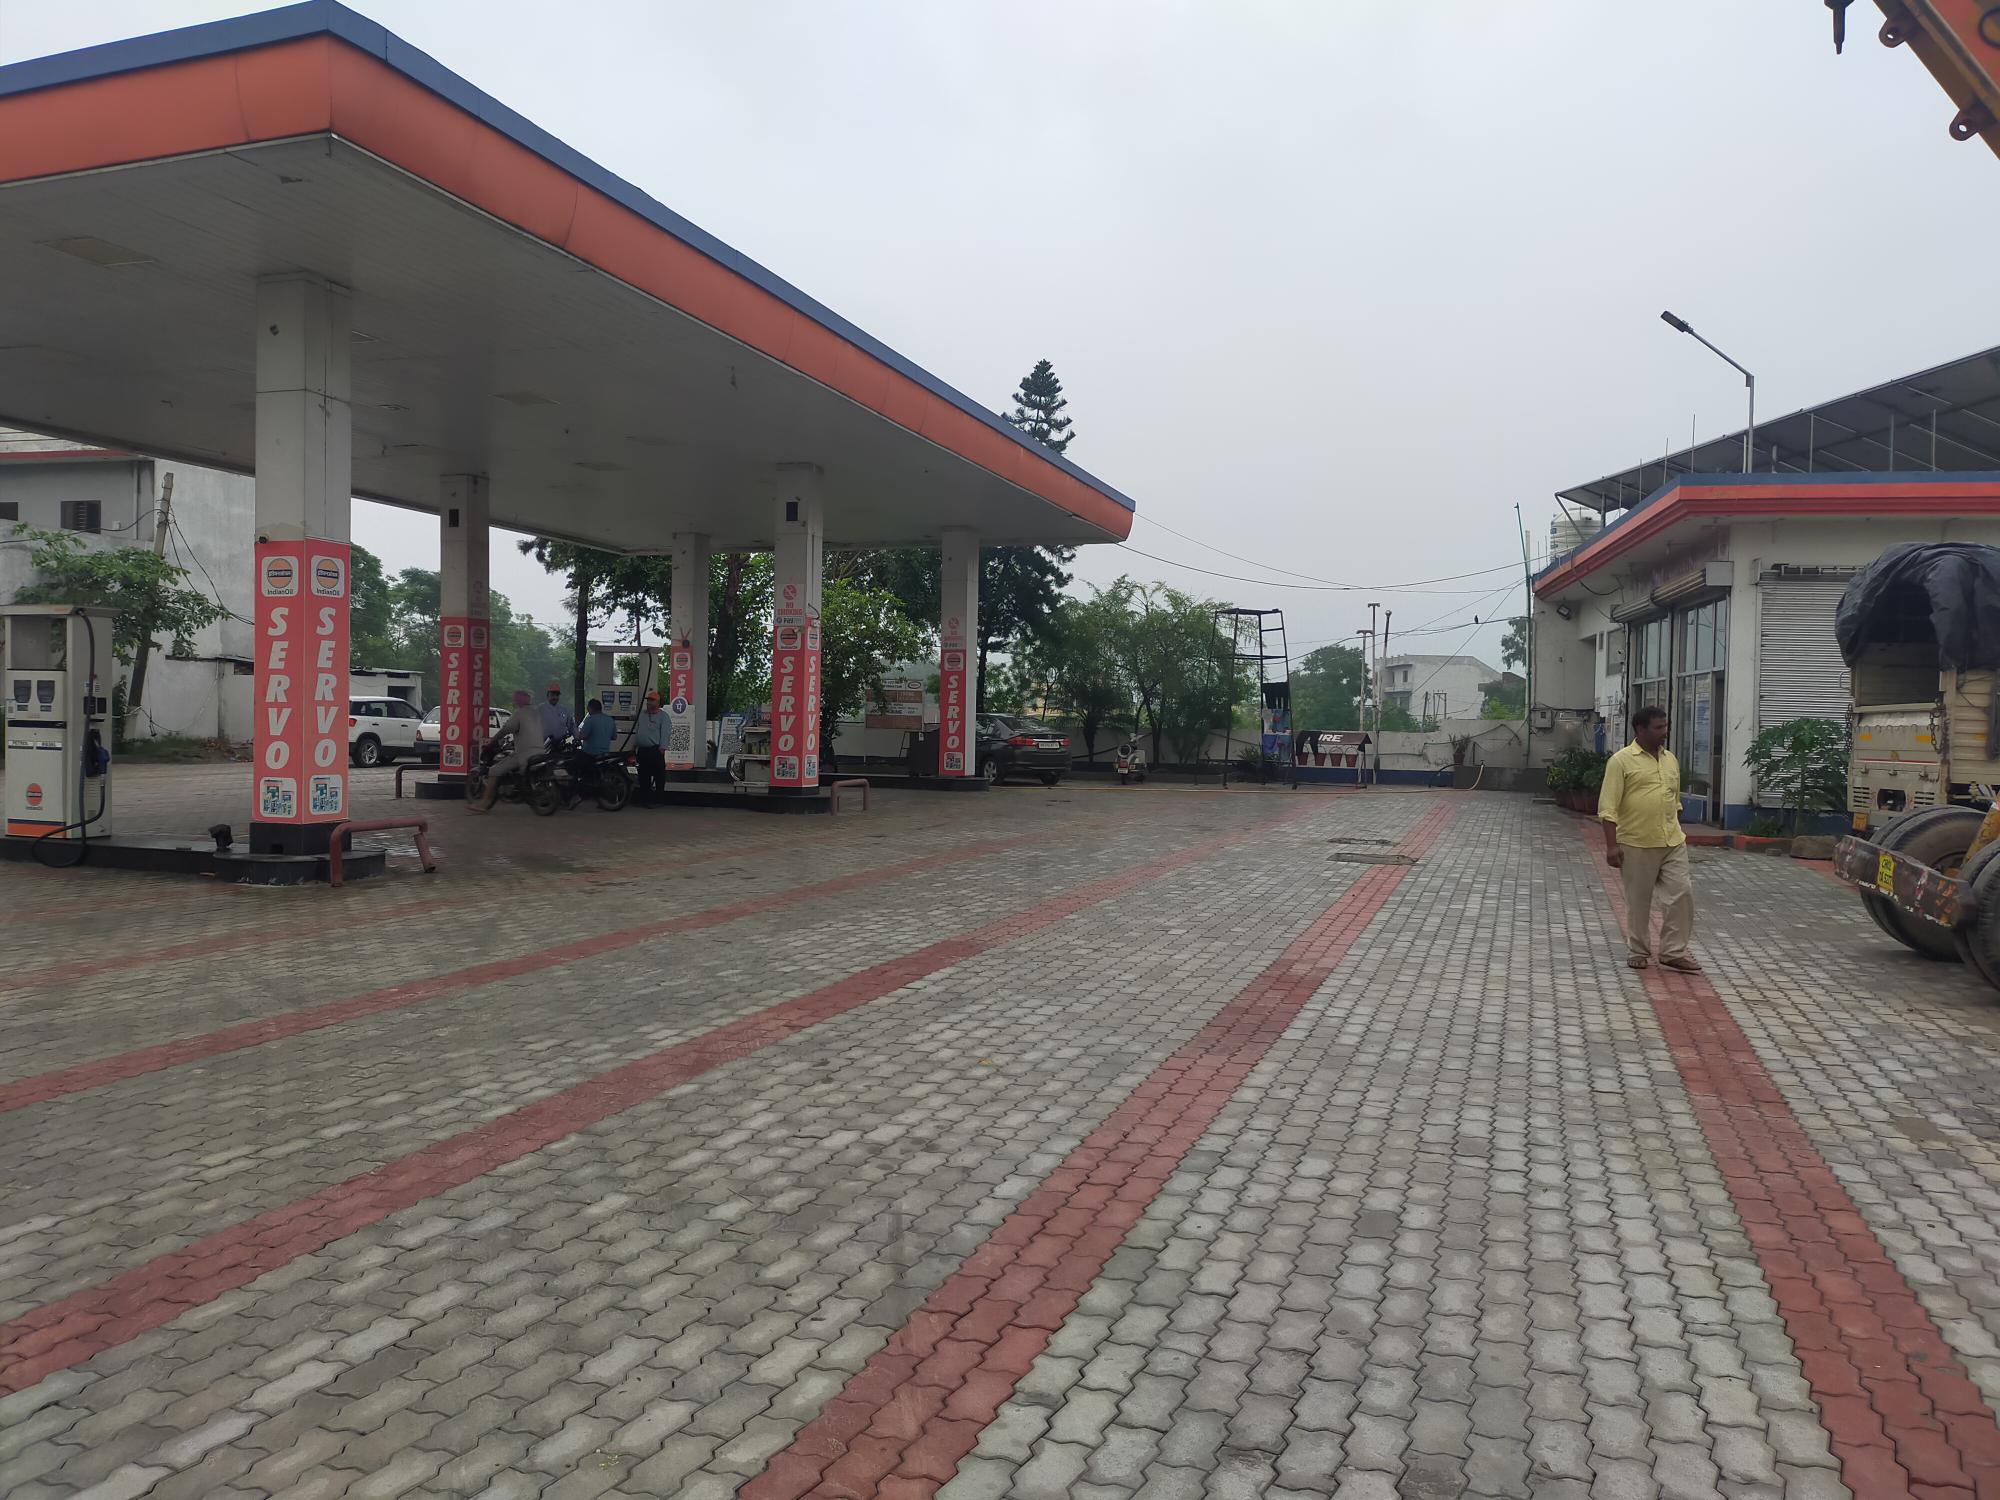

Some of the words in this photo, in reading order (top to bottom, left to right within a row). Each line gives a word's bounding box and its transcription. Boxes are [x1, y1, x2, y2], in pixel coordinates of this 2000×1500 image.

[266, 608, 291, 769] SERVO
[314, 606, 339, 768] SERVO
[447, 653, 460, 741] SERVO
[473, 653, 484, 741] SERVO
[779, 657, 796, 751] SERVO
[807, 656, 816, 750] SERVO
[946, 674, 960, 749] SERVO
[1318, 733, 1344, 742] IRE
